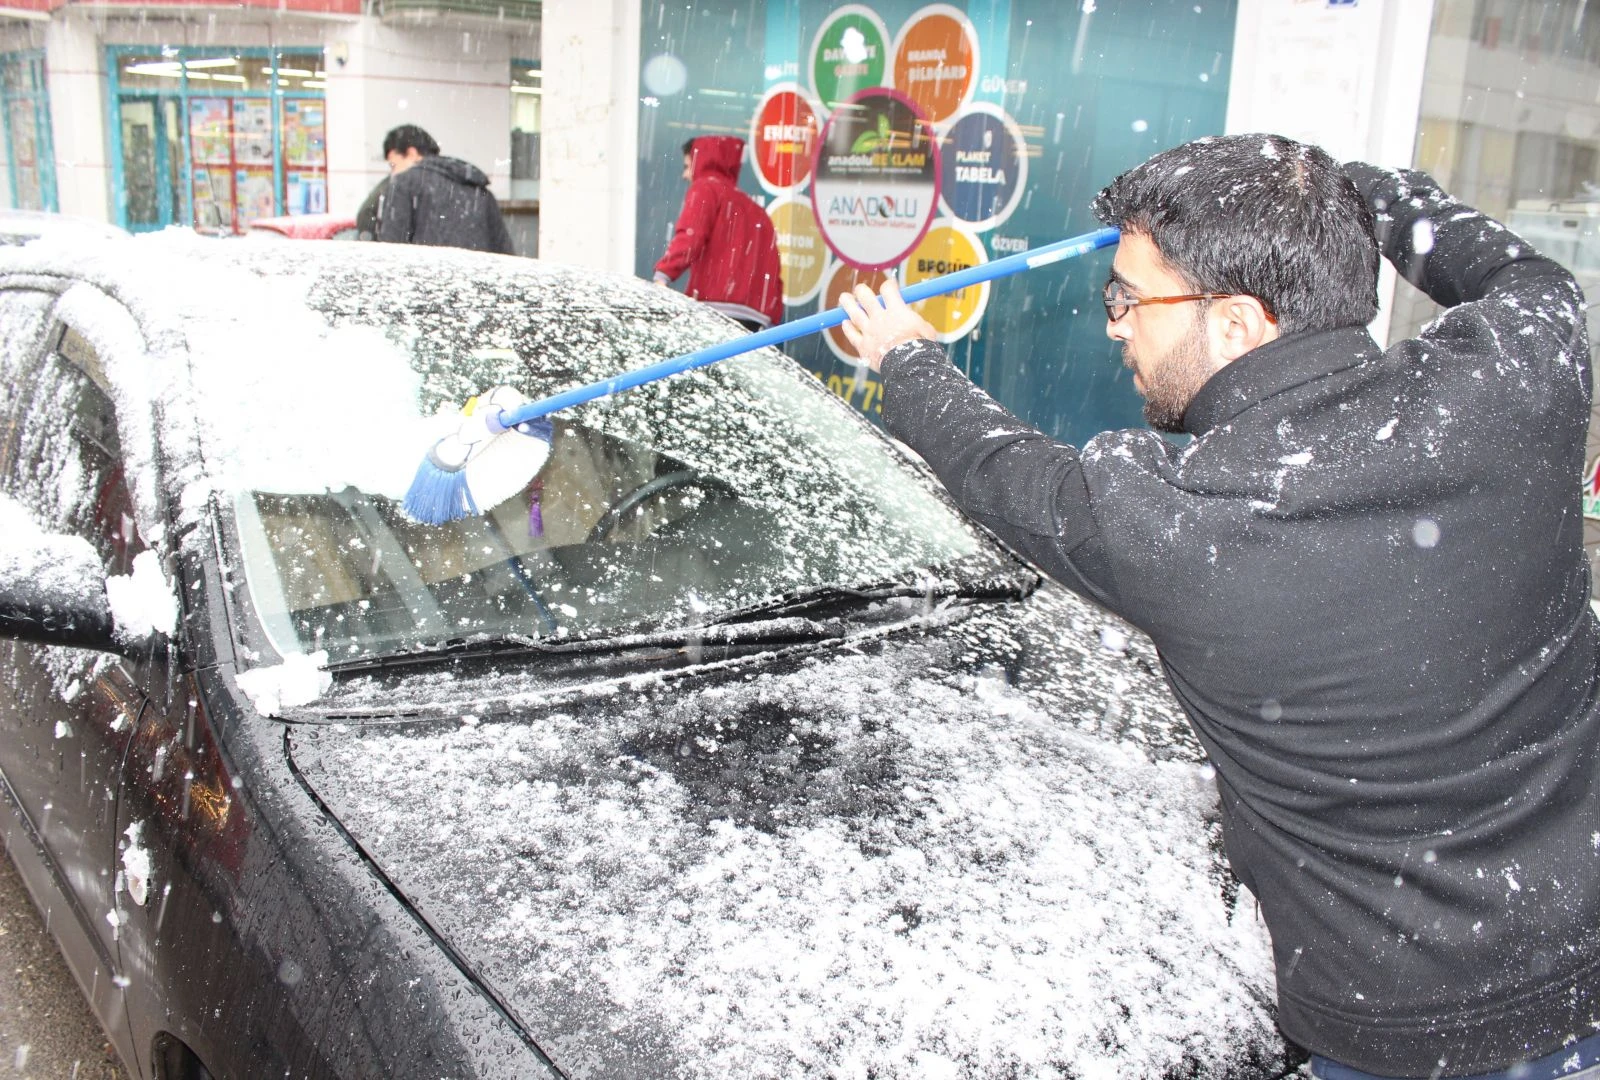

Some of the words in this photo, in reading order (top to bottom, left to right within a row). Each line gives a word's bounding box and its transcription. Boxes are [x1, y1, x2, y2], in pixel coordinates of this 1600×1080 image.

[955, 166, 1006, 185] TABELA
[828, 195, 918, 218] ANADOLU
[990, 235, 1029, 252] ÖZVERİ
